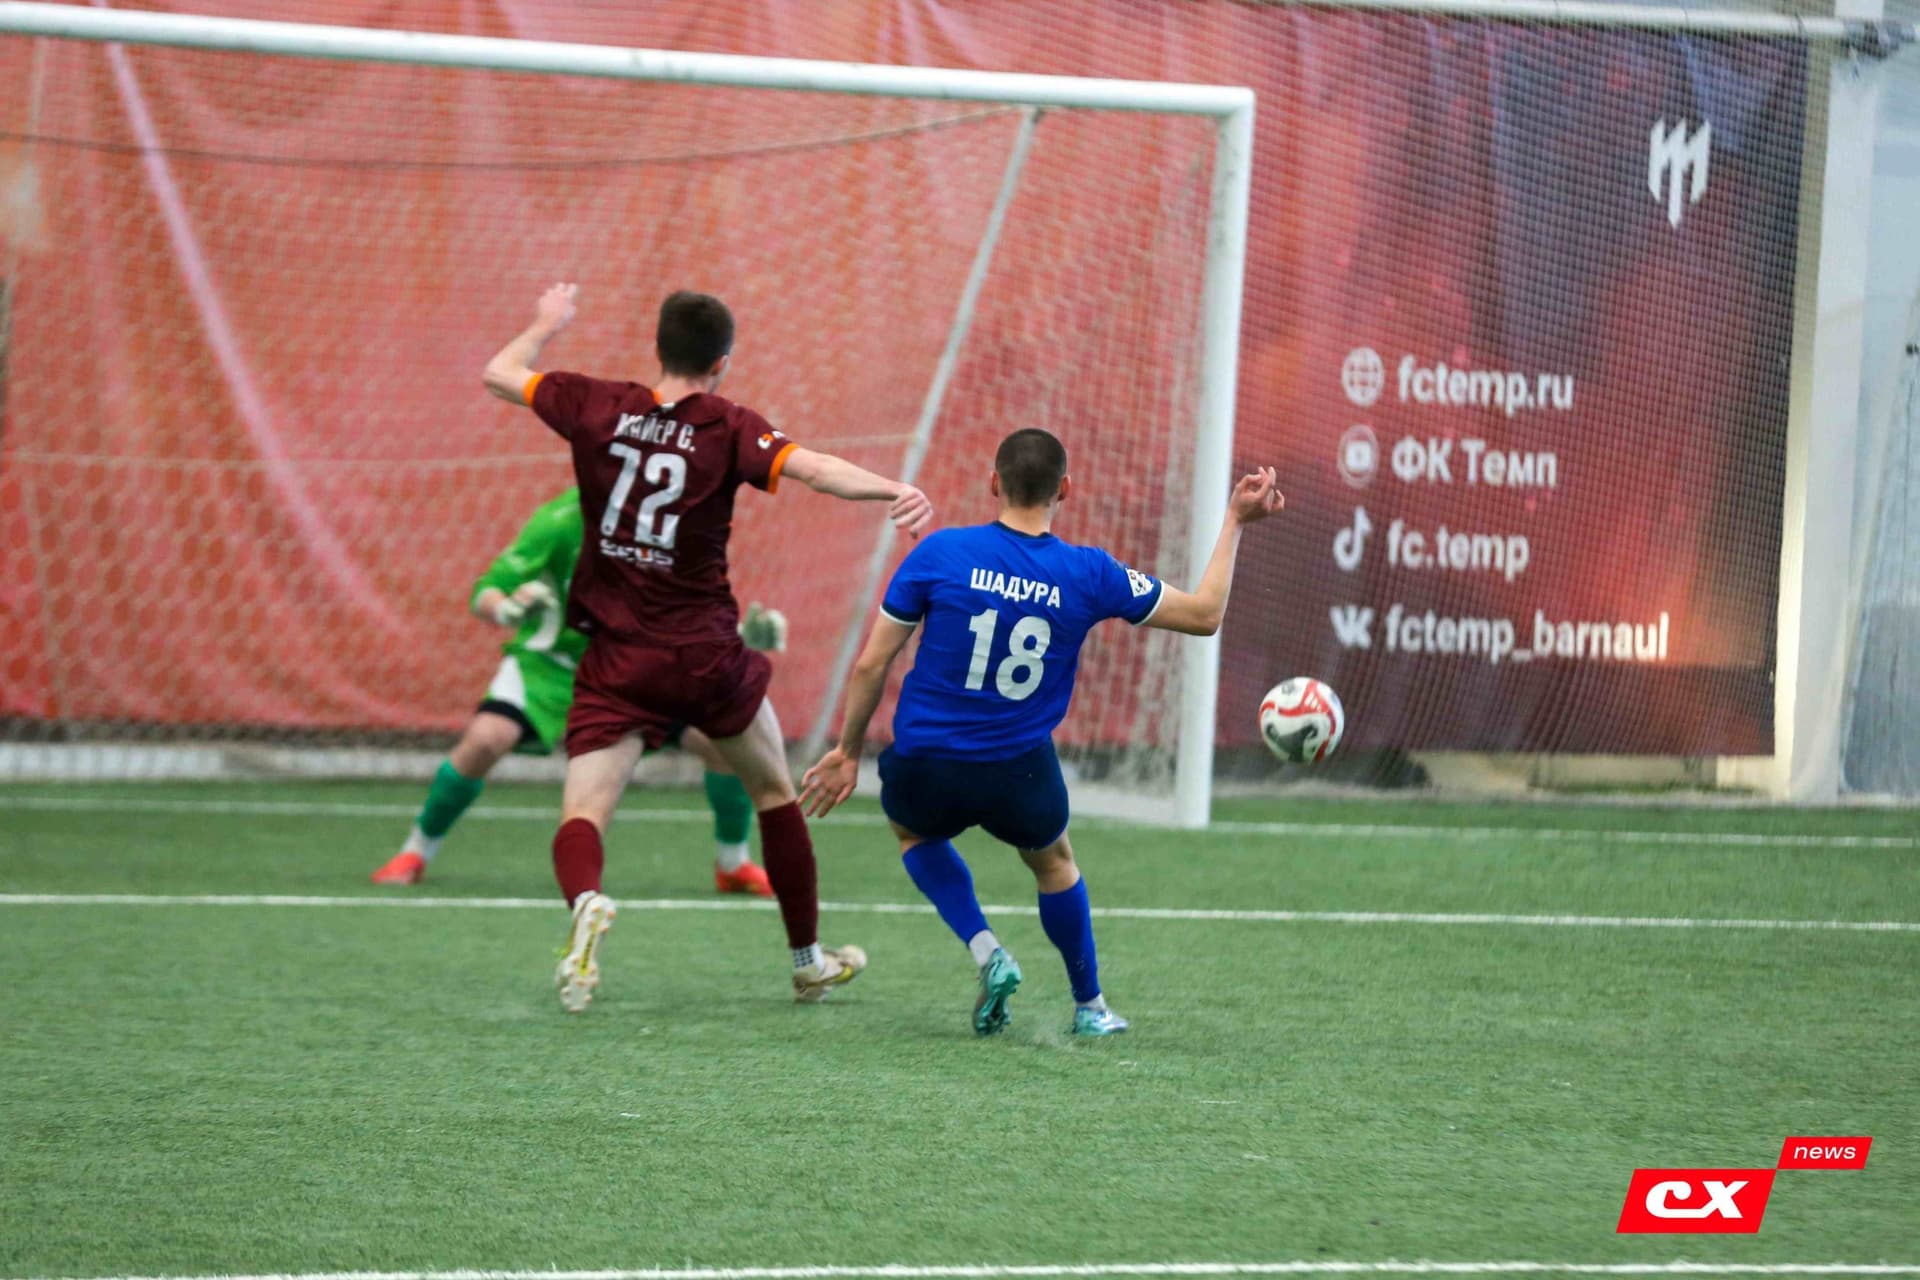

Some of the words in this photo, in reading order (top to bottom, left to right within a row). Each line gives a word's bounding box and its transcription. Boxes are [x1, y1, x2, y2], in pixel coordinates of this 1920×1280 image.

[1397, 354, 1574, 418] fctemp.ru
[1391, 435, 1451, 483] ФК
[1461, 437, 1557, 488] Темп
[601, 442, 687, 549] 72
[1387, 518, 1530, 582] fc.temp
[969, 567, 1061, 608] ШАДУРА
[965, 608, 1051, 701] 18
[1385, 602, 1670, 664] fctemp_barnaul
